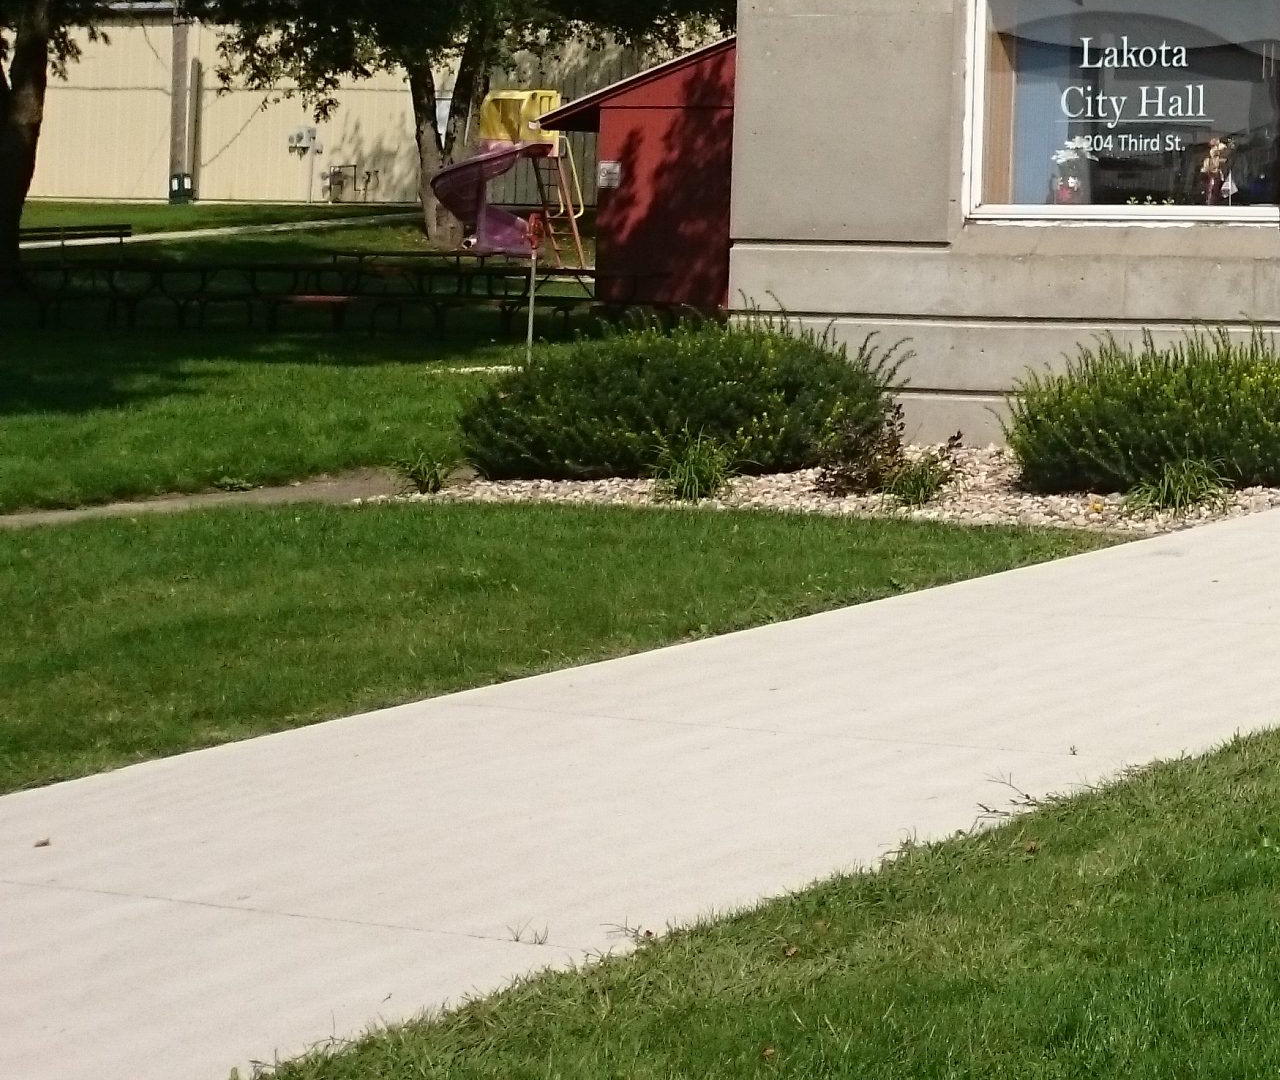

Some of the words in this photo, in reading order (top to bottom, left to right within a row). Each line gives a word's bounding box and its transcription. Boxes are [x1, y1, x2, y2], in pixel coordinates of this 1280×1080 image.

[1079, 36, 1189, 68] Lakota
[1060, 86, 1128, 129] City
[1138, 84, 1206, 117] Hall
[1117, 133, 1160, 152] Third
[1165, 134, 1186, 152] St.
